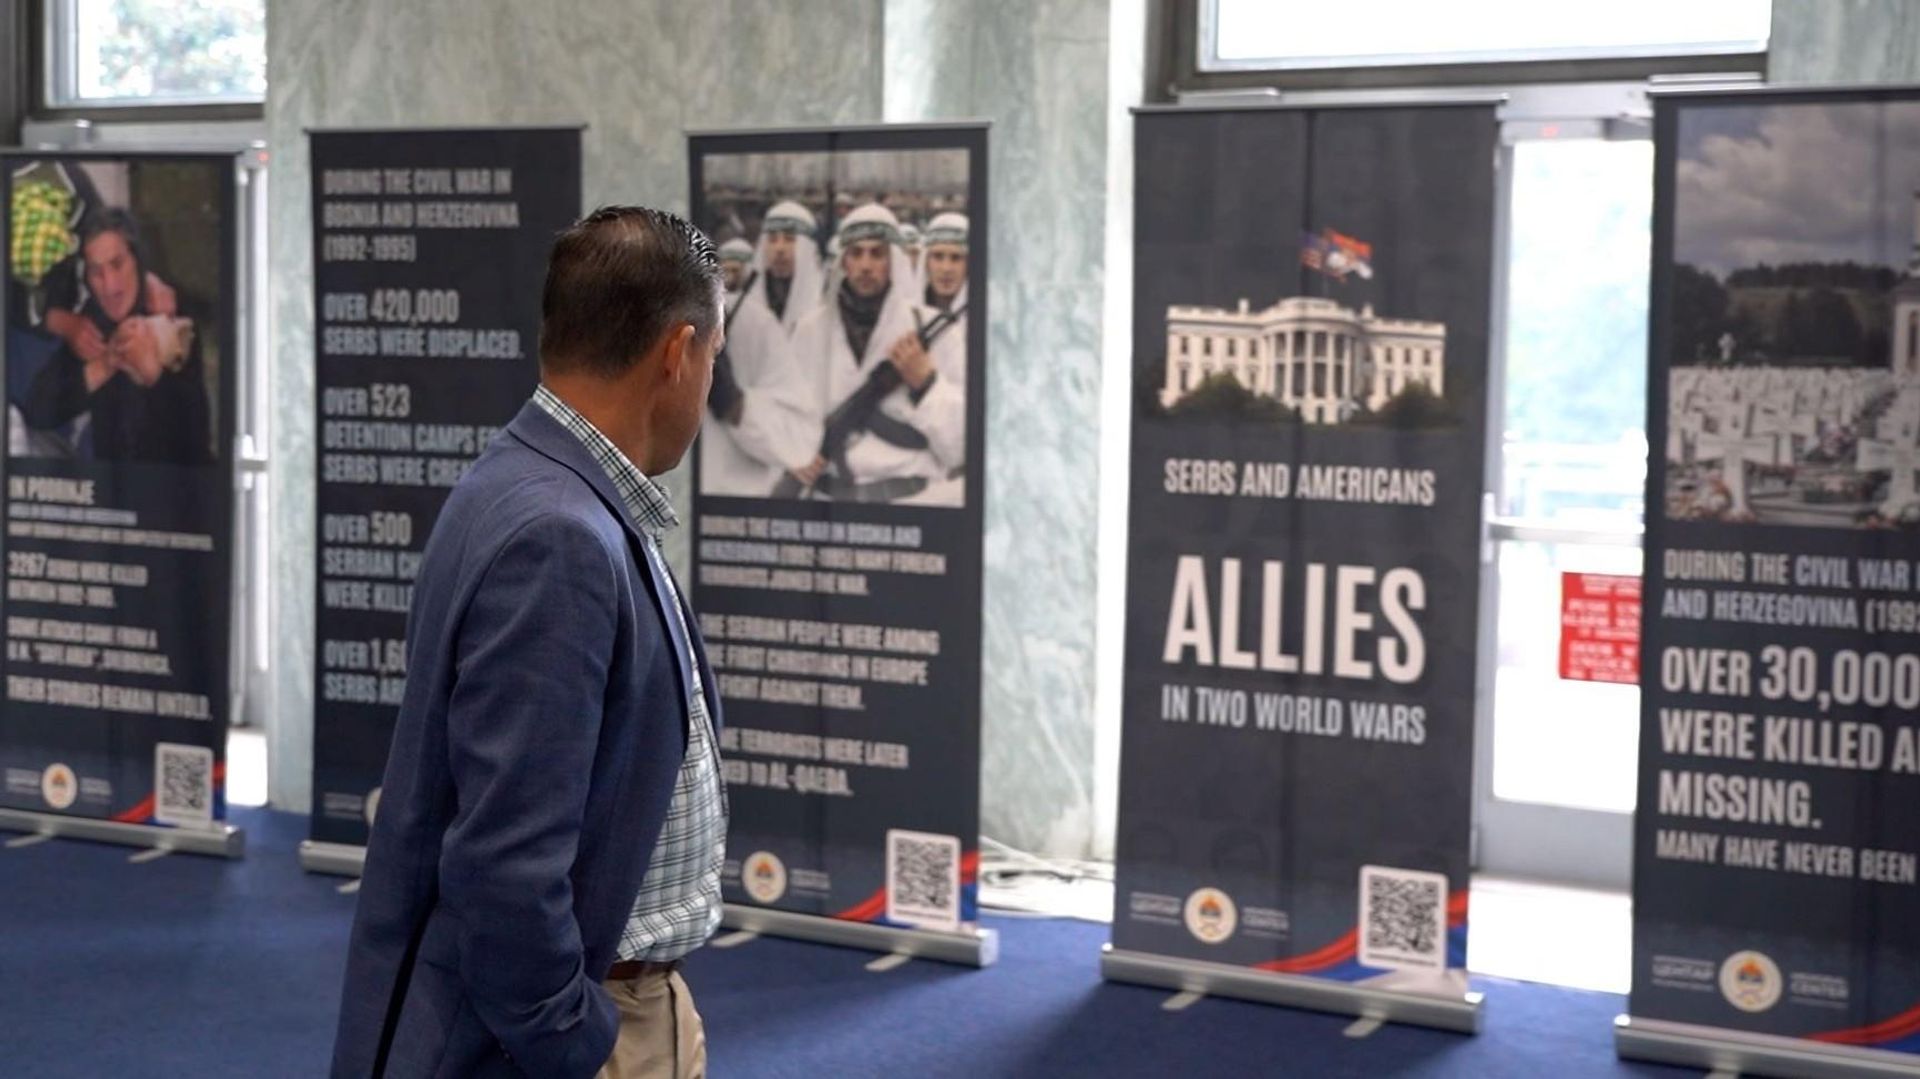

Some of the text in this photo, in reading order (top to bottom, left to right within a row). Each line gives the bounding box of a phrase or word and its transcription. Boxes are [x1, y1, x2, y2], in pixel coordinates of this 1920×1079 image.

[384, 169, 411, 194] THE
[414, 169, 453, 194] CIVIL
[455, 169, 491, 194] WAR
[383, 202, 413, 228] AND
[324, 289, 459, 327] OVER 420,000
[323, 327, 524, 358] SERBS WERE DISPLACED.
[324, 384, 410, 416] OVER 523
[323, 421, 411, 450] DETENTION
[414, 423, 474, 454] CAMPS
[323, 454, 377, 483] SERBS
[380, 457, 426, 485] WERE
[1164, 458, 1435, 506] SERBS AND AMERICANS
[324, 512, 412, 545] OVER 500
[323, 548, 394, 577] SERBIAN
[1664, 549, 1746, 583] DURING
[1752, 552, 1789, 585] THE
[1795, 554, 1850, 589] CIVIL
[1858, 558, 1909, 591] WAR
[323, 580, 370, 608] WERE
[1662, 589, 1707, 620] AND
[1713, 591, 1858, 629] HERZEGOVINA
[1163, 554, 1426, 683] ALLIES
[324, 639, 367, 668] OVER
[323, 672, 377, 701] SERBS
[1661, 644, 1920, 711] OVER 30,000
[1161, 684, 1425, 745] IN TWO WORLD WARS
[1659, 708, 1920, 774] WERE KILLED A
[1659, 770, 1821, 829] MISSING.
[1656, 829, 1916, 883] MANY HAVE NEVER BEEN
